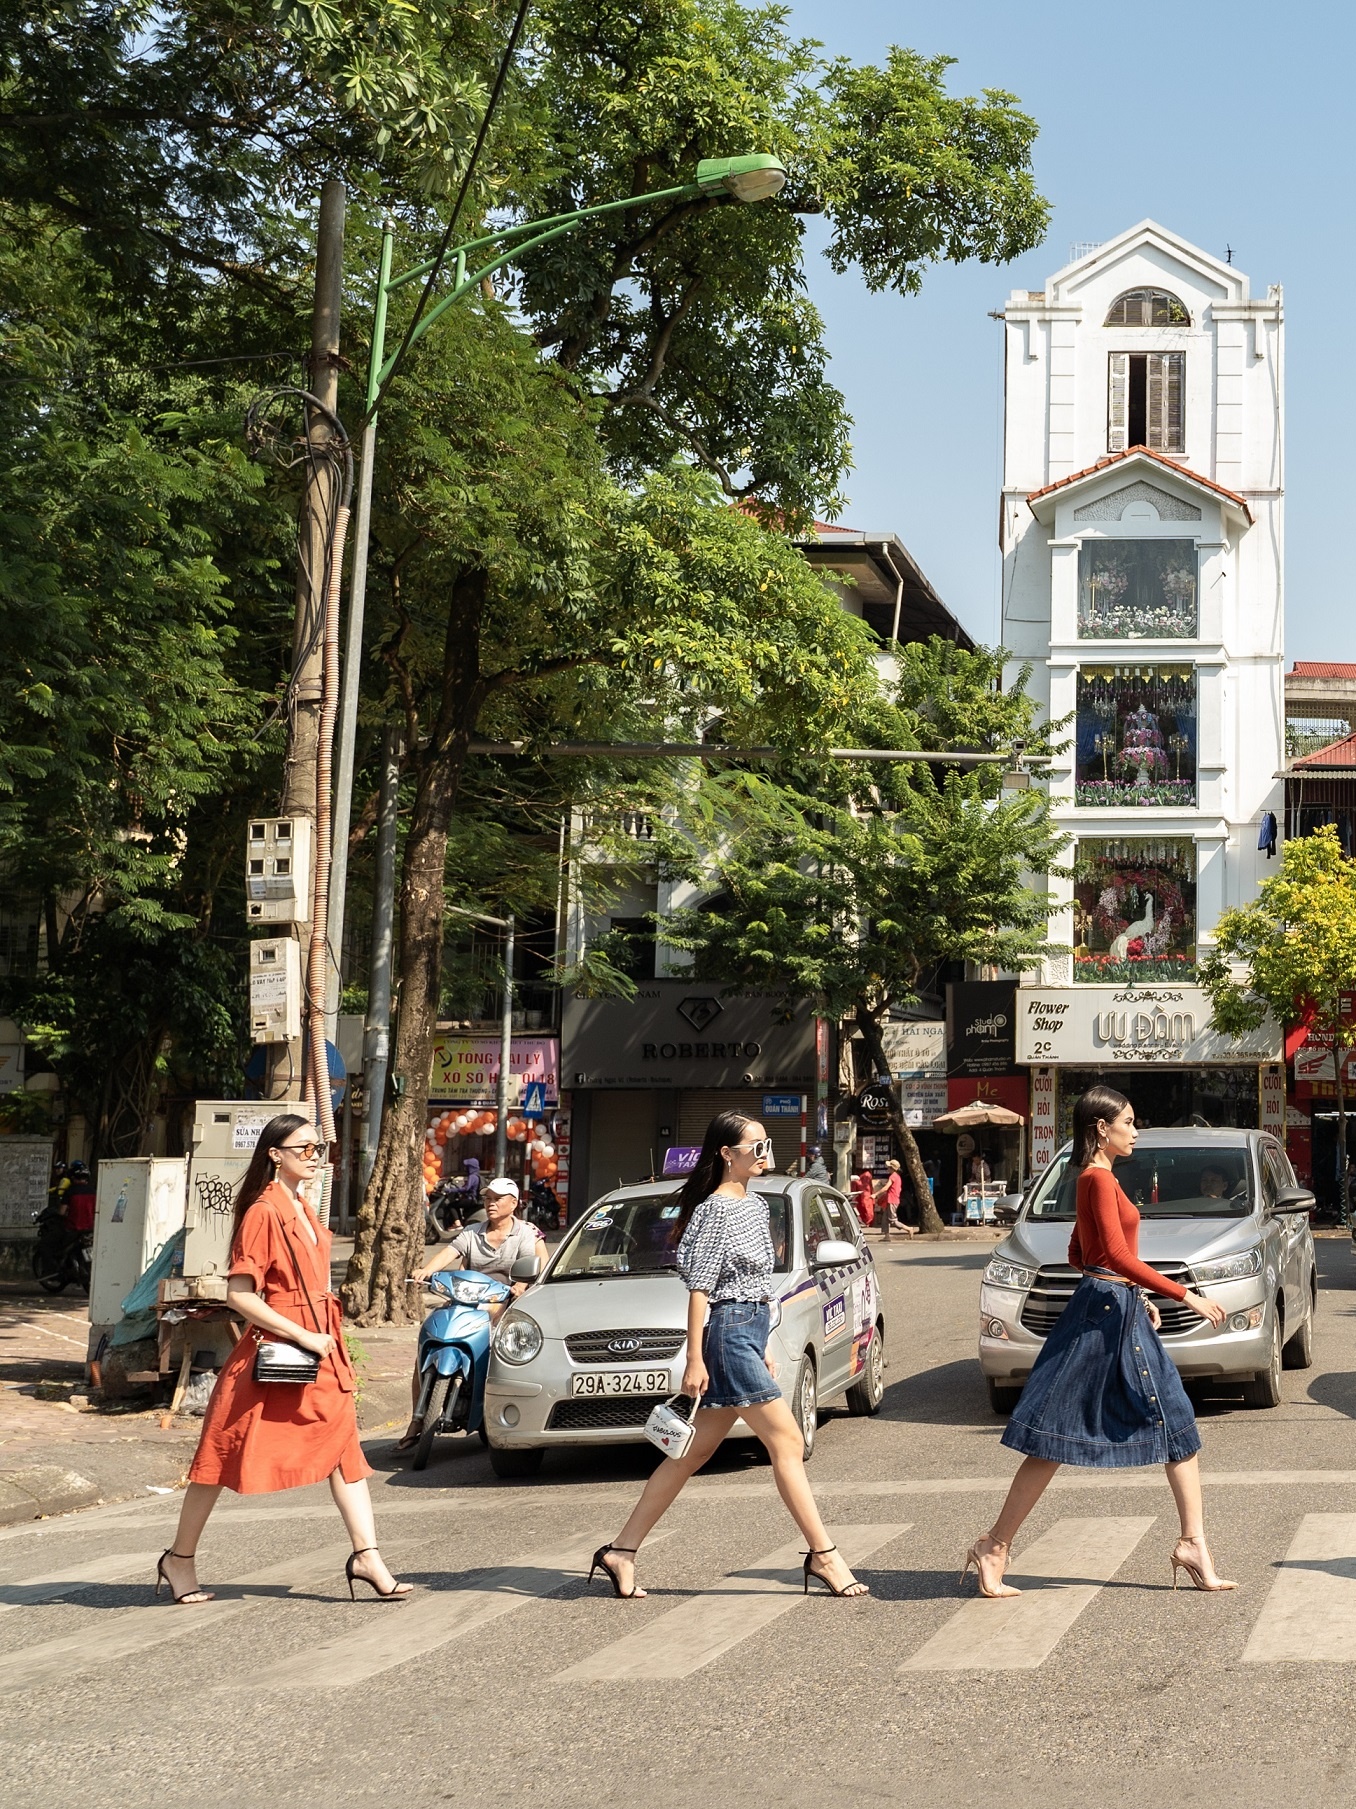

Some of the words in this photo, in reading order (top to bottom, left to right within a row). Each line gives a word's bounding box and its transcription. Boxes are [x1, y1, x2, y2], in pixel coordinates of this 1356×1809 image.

[1028, 1001, 1069, 1015] Flower
[1033, 1018, 1063, 1032] Shop
[642, 1042, 761, 1058] ROBERTO
[1034, 1076, 1053, 1092] CƯỚI
[1263, 1074, 1282, 1090] CƯỚI
[1037, 1097, 1050, 1116] HỎI
[1266, 1095, 1280, 1114] HỎI
[1034, 1125, 1054, 1143] TRỌN
[1036, 1147, 1050, 1164] GÓI
[613, 1340, 635, 1350] KIA
[575, 1373, 666, 1394] 29A-324.92
